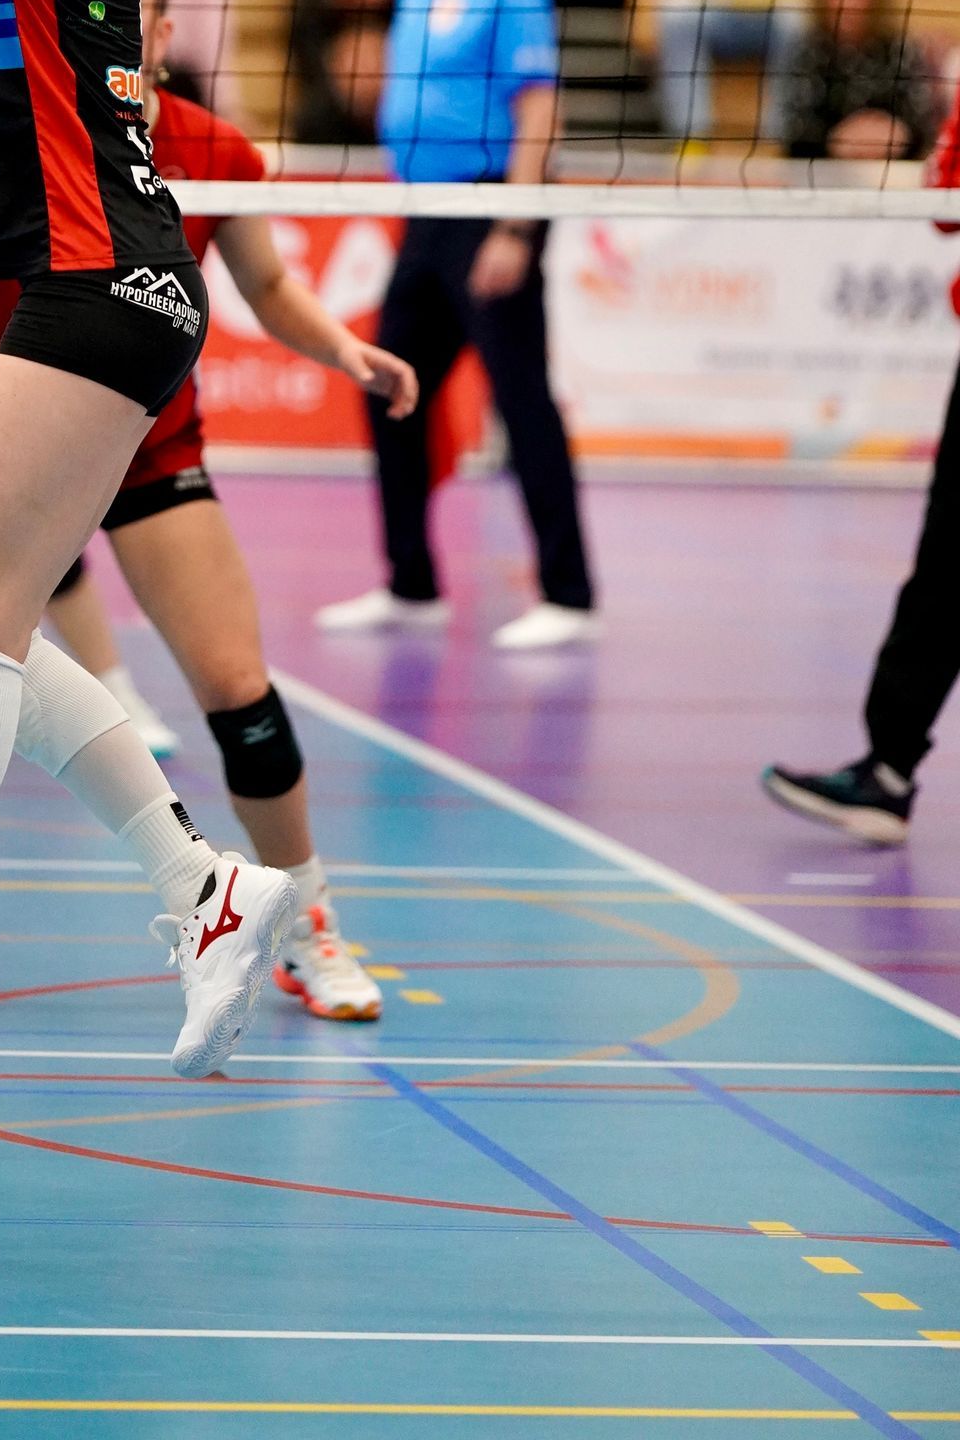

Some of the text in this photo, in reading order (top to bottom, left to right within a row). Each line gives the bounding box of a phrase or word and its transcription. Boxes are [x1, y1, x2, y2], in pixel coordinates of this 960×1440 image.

[110, 281, 201, 325] HYPOTHEEKADVIES
[172, 315, 199, 338] OP MAAT
